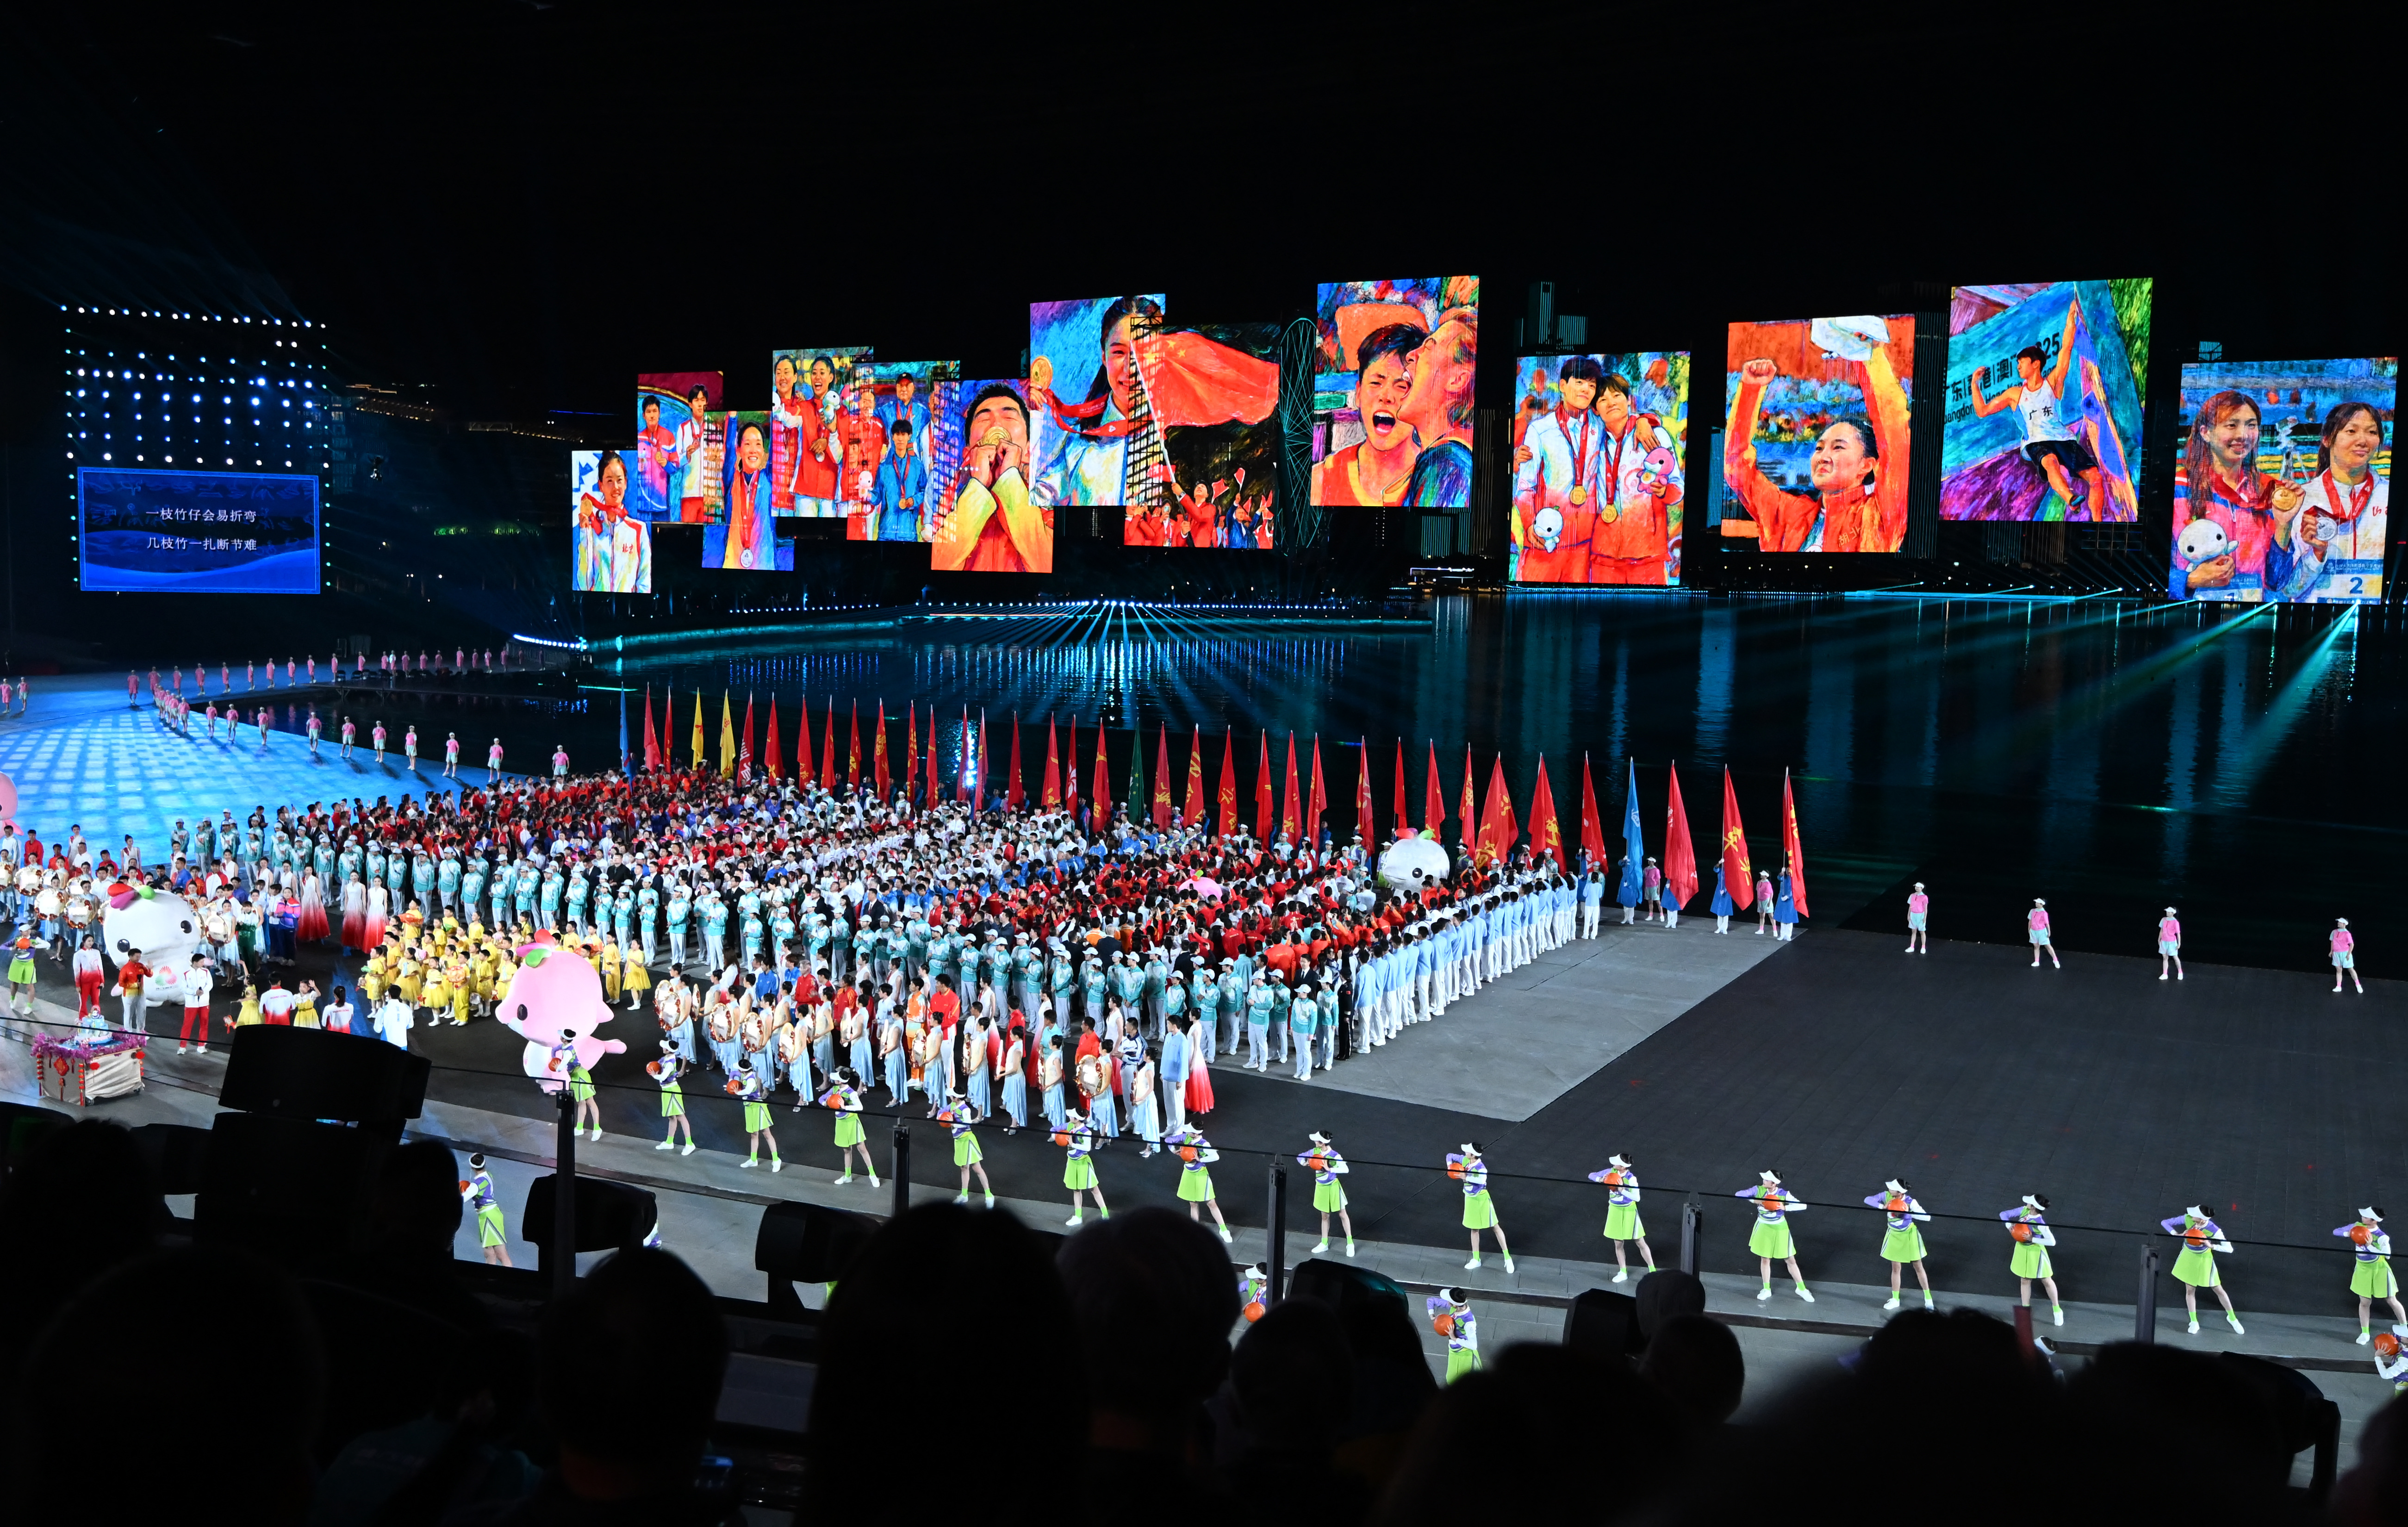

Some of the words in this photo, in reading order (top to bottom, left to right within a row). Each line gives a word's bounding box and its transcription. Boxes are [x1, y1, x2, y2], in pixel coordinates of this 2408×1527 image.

[2029, 405, 2053, 421] 广东
[145, 508, 257, 523] 一枝竹仔会易折弯
[146, 537, 257, 551] 几枝竹一扎断节难
[2349, 577, 2363, 594] 2
